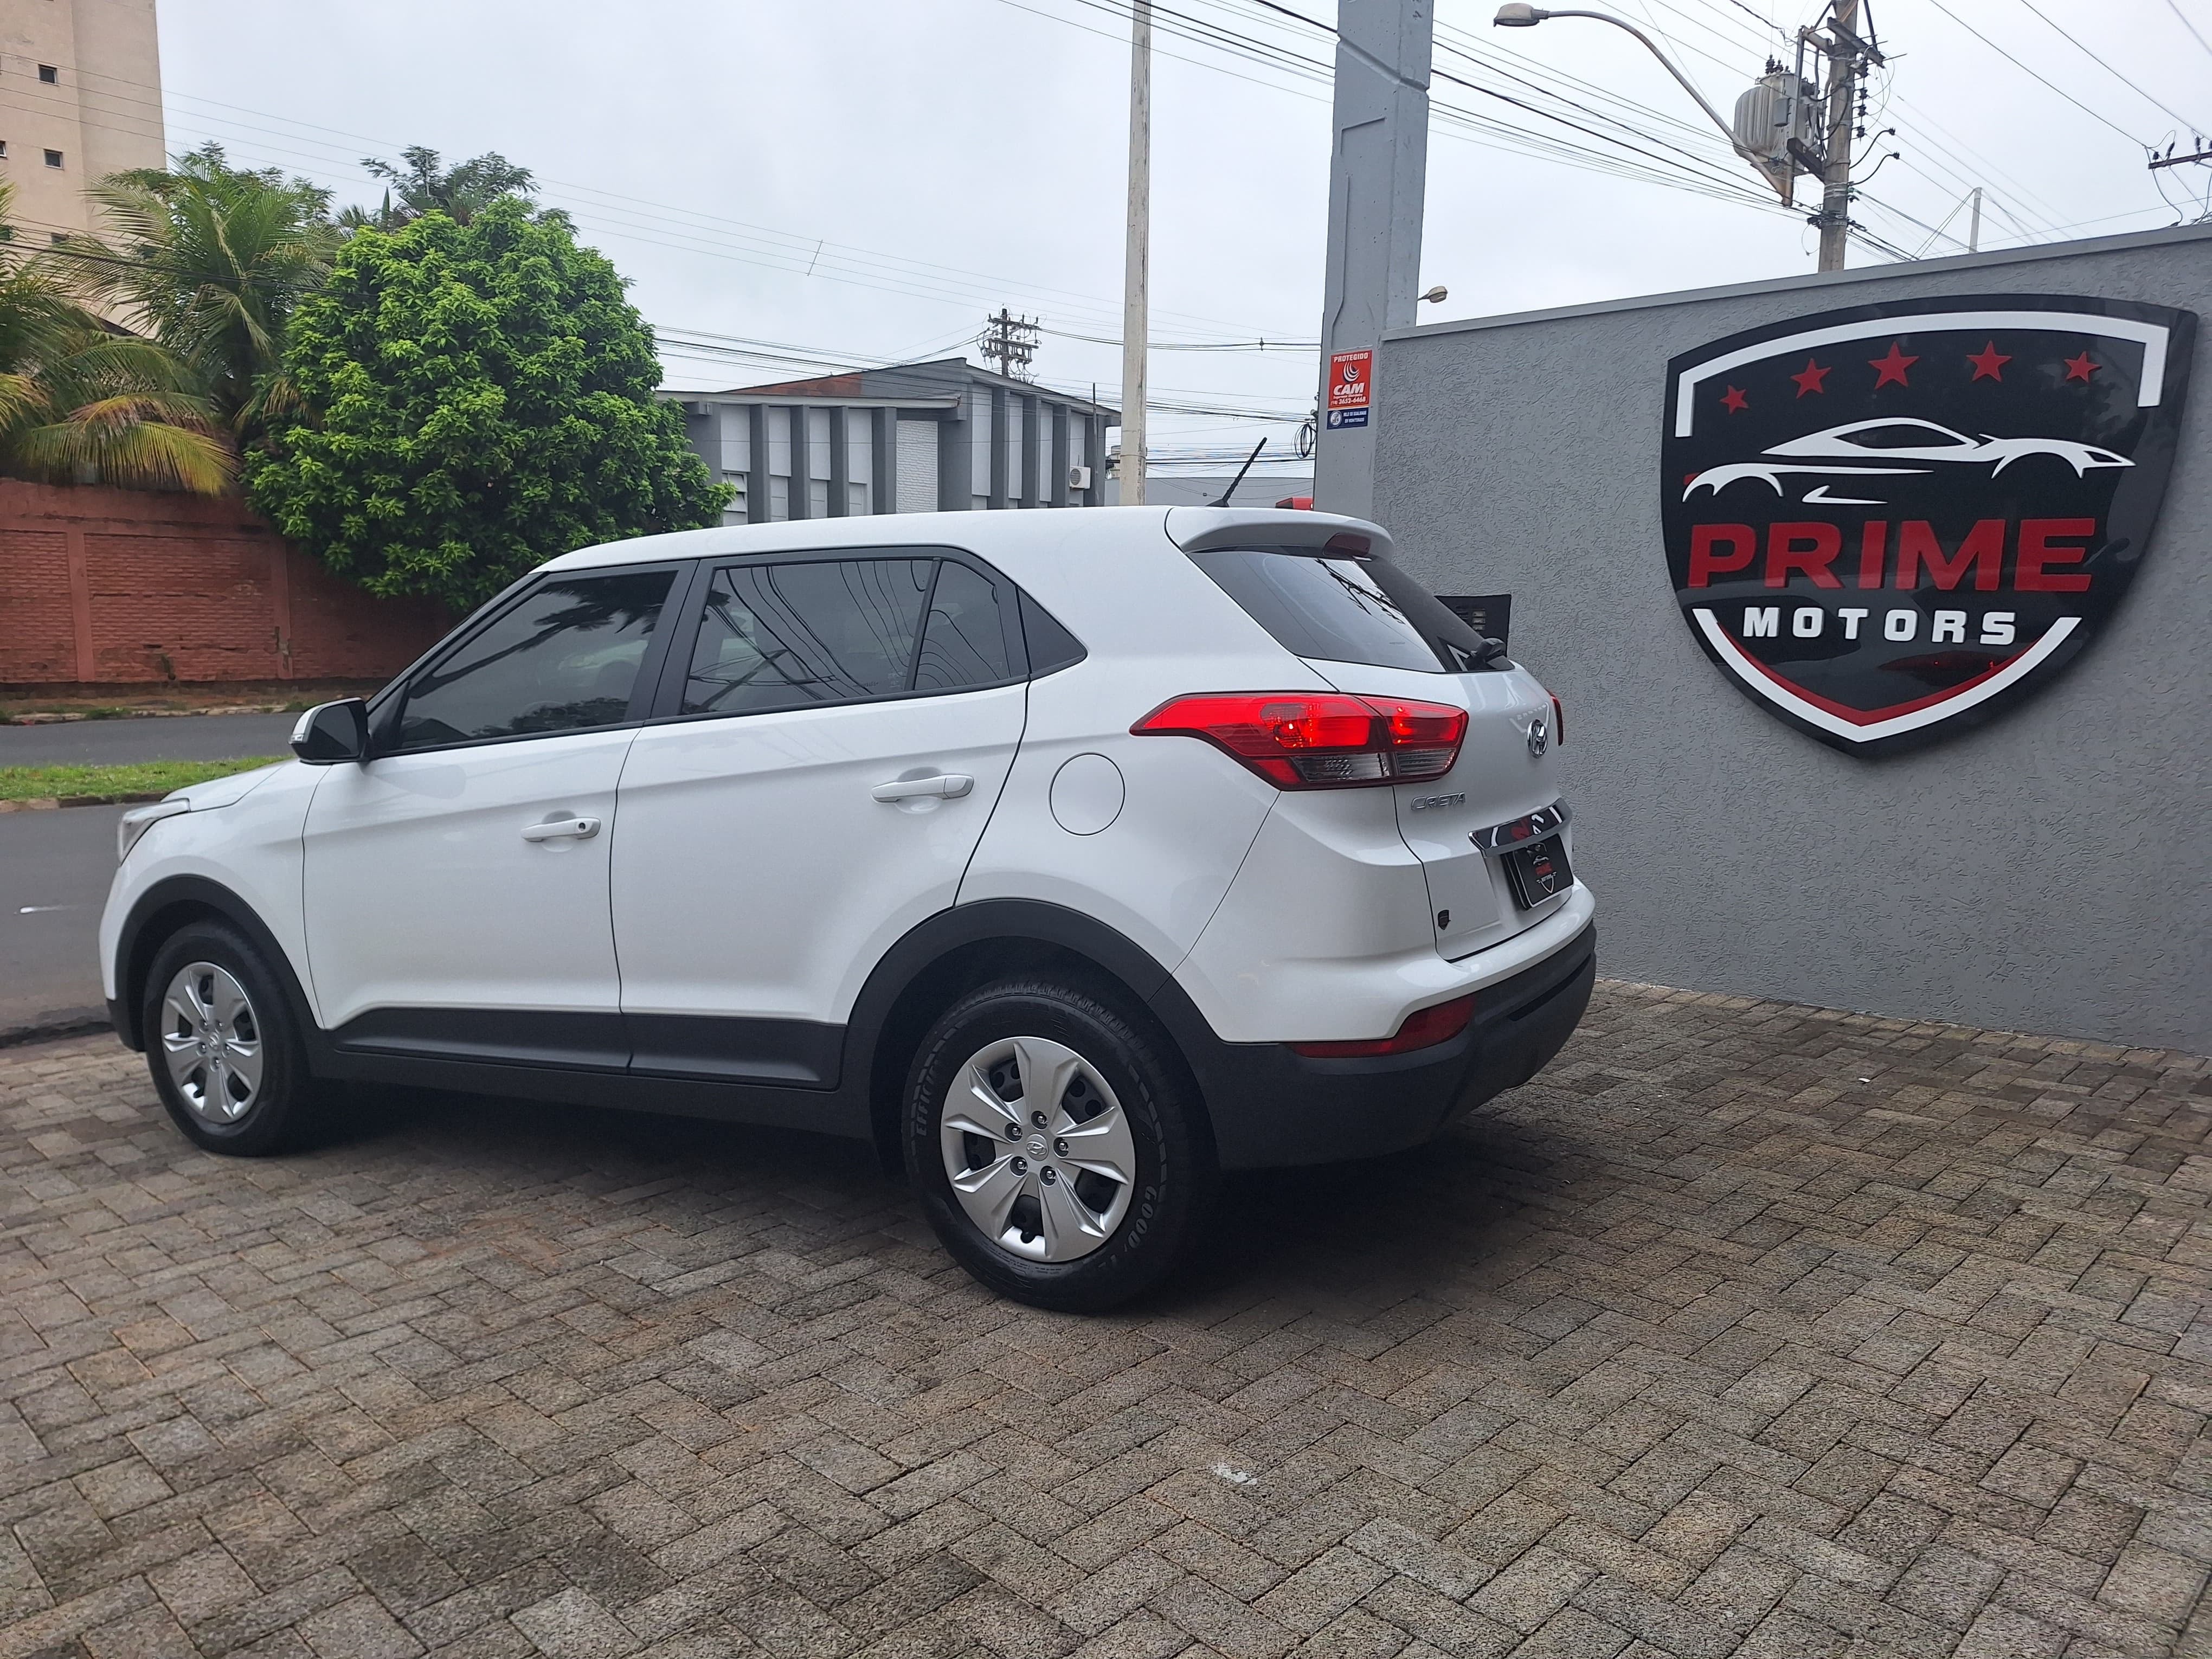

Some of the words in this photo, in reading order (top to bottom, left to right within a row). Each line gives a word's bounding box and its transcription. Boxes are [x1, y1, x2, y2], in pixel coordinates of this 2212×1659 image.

[1334, 352, 1368, 363] PROTEGIDO
[1333, 383, 1365, 396] CAM
[1686, 518, 2097, 592] PRIME
[1742, 606, 2017, 646] MOTORS
[1411, 792, 1465, 811] CRETA
